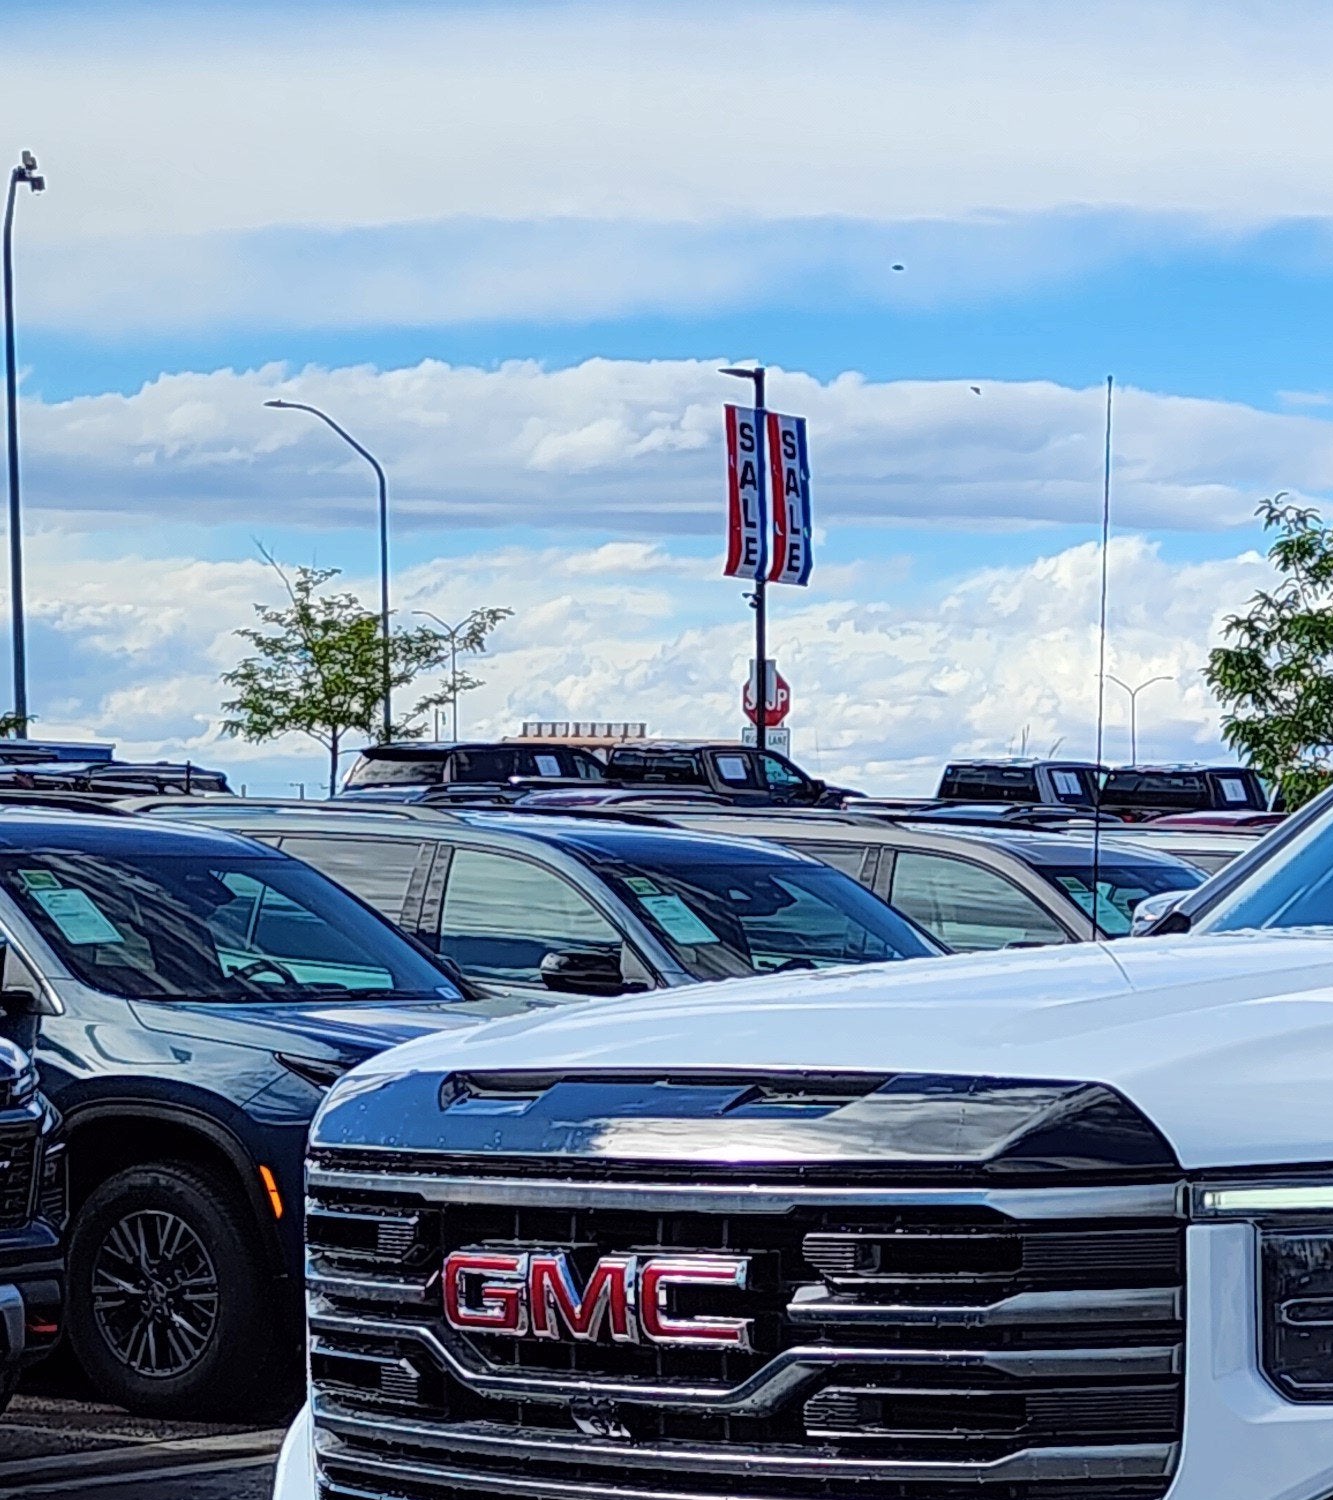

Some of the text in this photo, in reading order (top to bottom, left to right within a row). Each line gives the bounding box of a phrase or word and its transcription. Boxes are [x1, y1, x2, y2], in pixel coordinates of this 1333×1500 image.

[739, 422, 757, 566] SALE
[782, 429, 800, 573] SALE
[745, 688, 788, 711] SP
[444, 1250, 754, 1349] GMC
